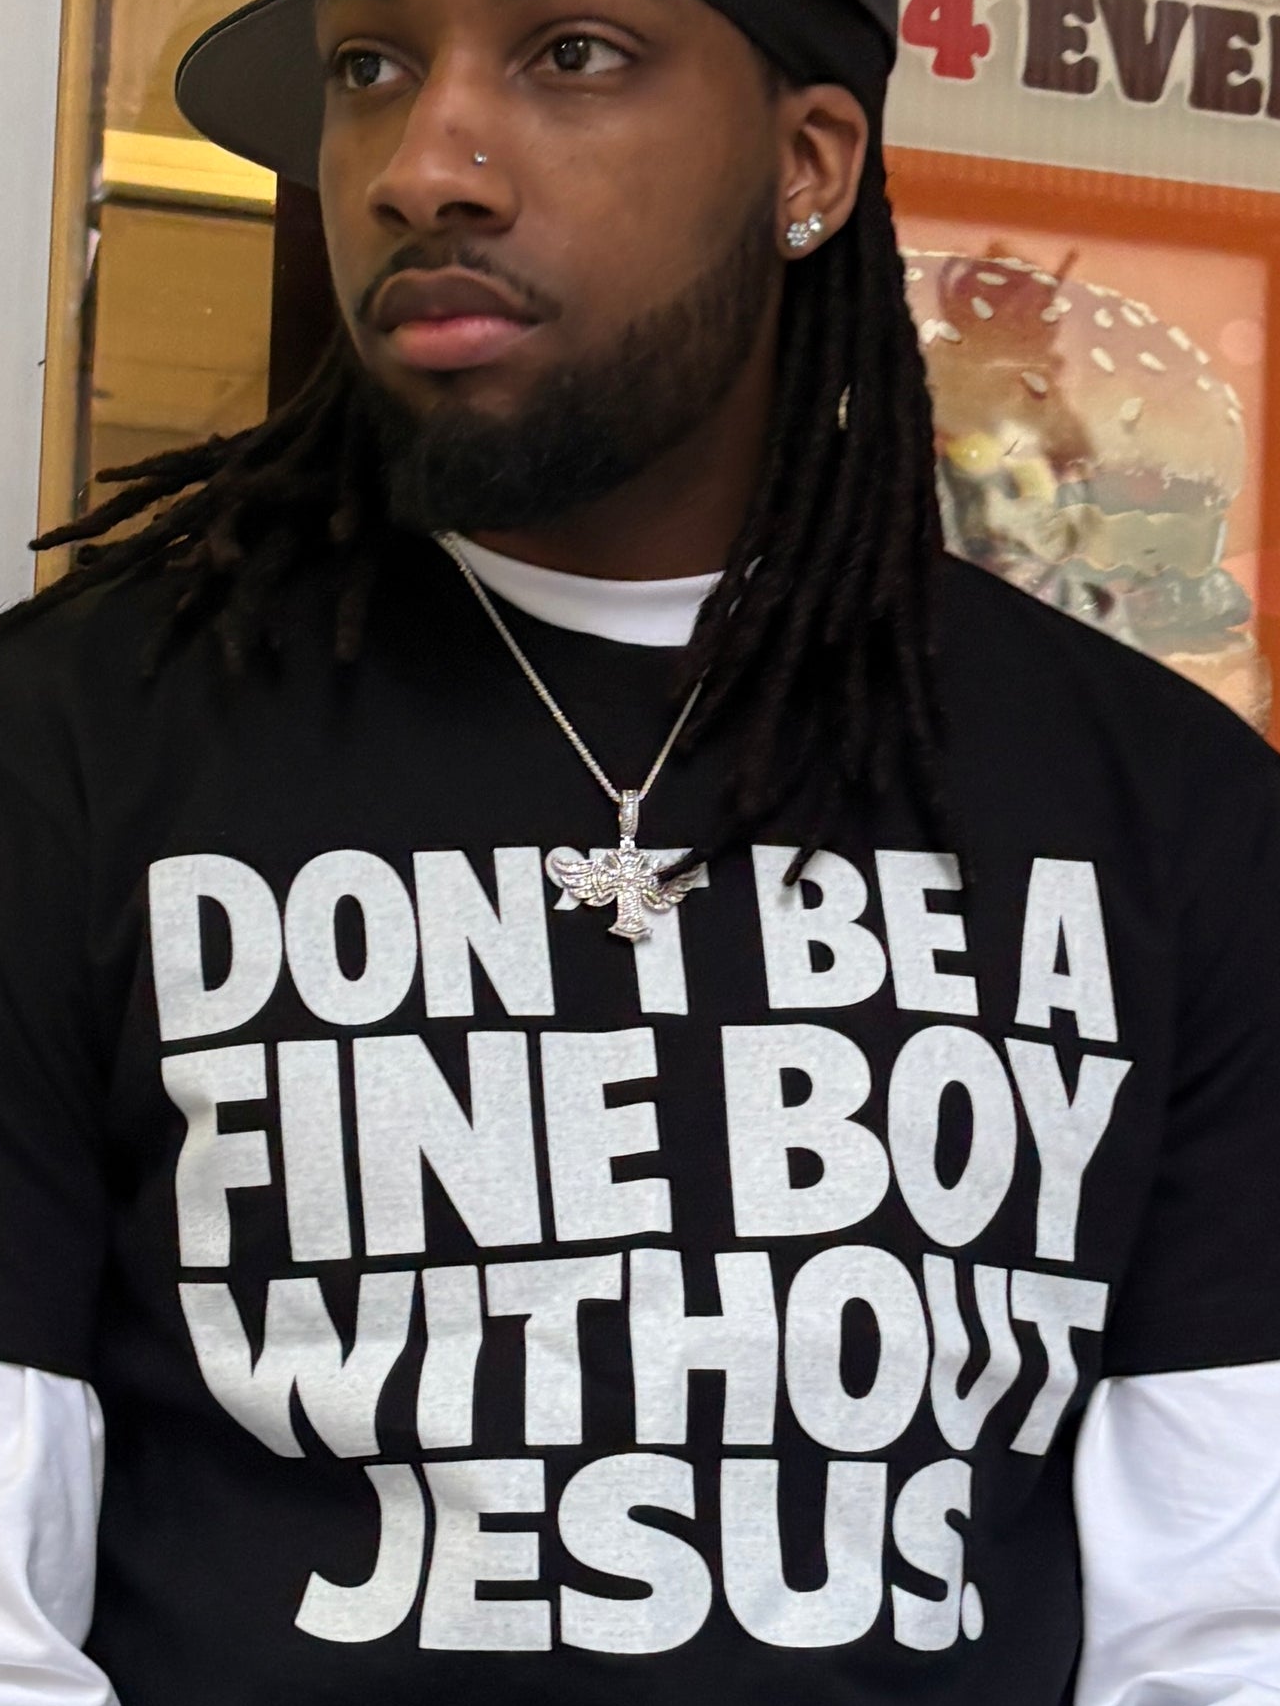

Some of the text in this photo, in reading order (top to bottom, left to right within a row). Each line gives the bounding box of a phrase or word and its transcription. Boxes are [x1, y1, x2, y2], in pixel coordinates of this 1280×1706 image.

[750, 844, 980, 1018] BE
[1014, 856, 1119, 1043] A
[159, 1023, 1134, 1268] FINE BOY
[177, 1244, 1110, 1459] WITHOUT
[293, 1452, 984, 1655] JESUS.
